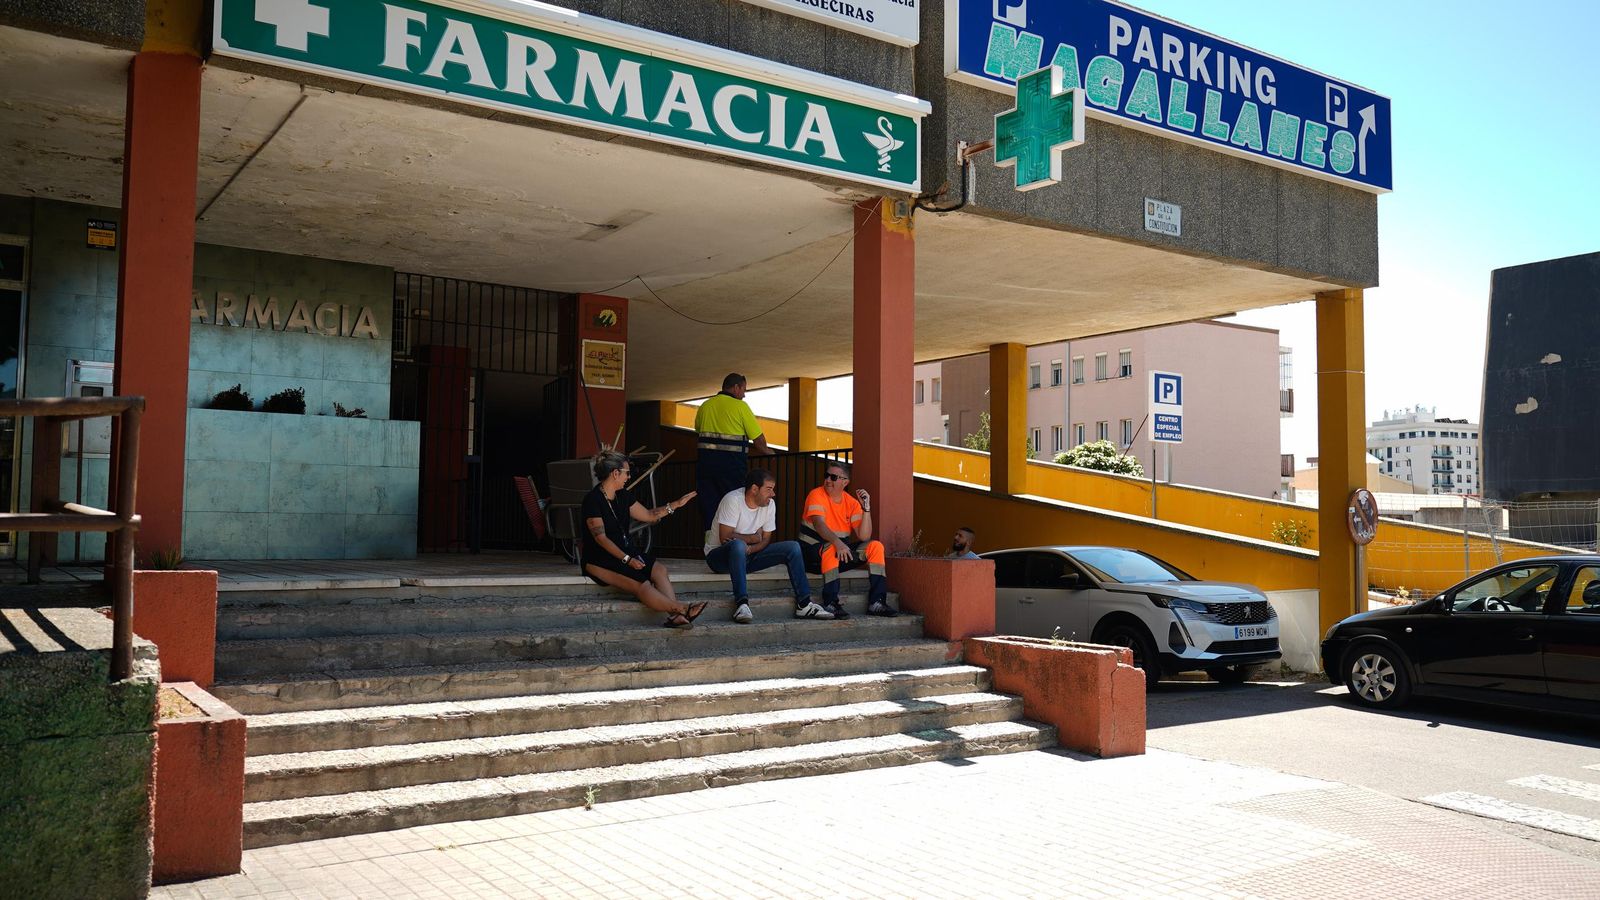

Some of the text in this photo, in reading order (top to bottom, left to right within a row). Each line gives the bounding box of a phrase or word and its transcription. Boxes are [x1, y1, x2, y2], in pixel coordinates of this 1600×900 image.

[1109, 14, 1277, 106] PARKING
[379, 3, 845, 162] FARMACIA
[1329, 86, 1346, 122] P
[1157, 204, 1173, 214] PLAZA
[191, 289, 379, 339] ARMACIA
[1163, 382, 1174, 399] P
[1239, 628, 1255, 637] 6199
